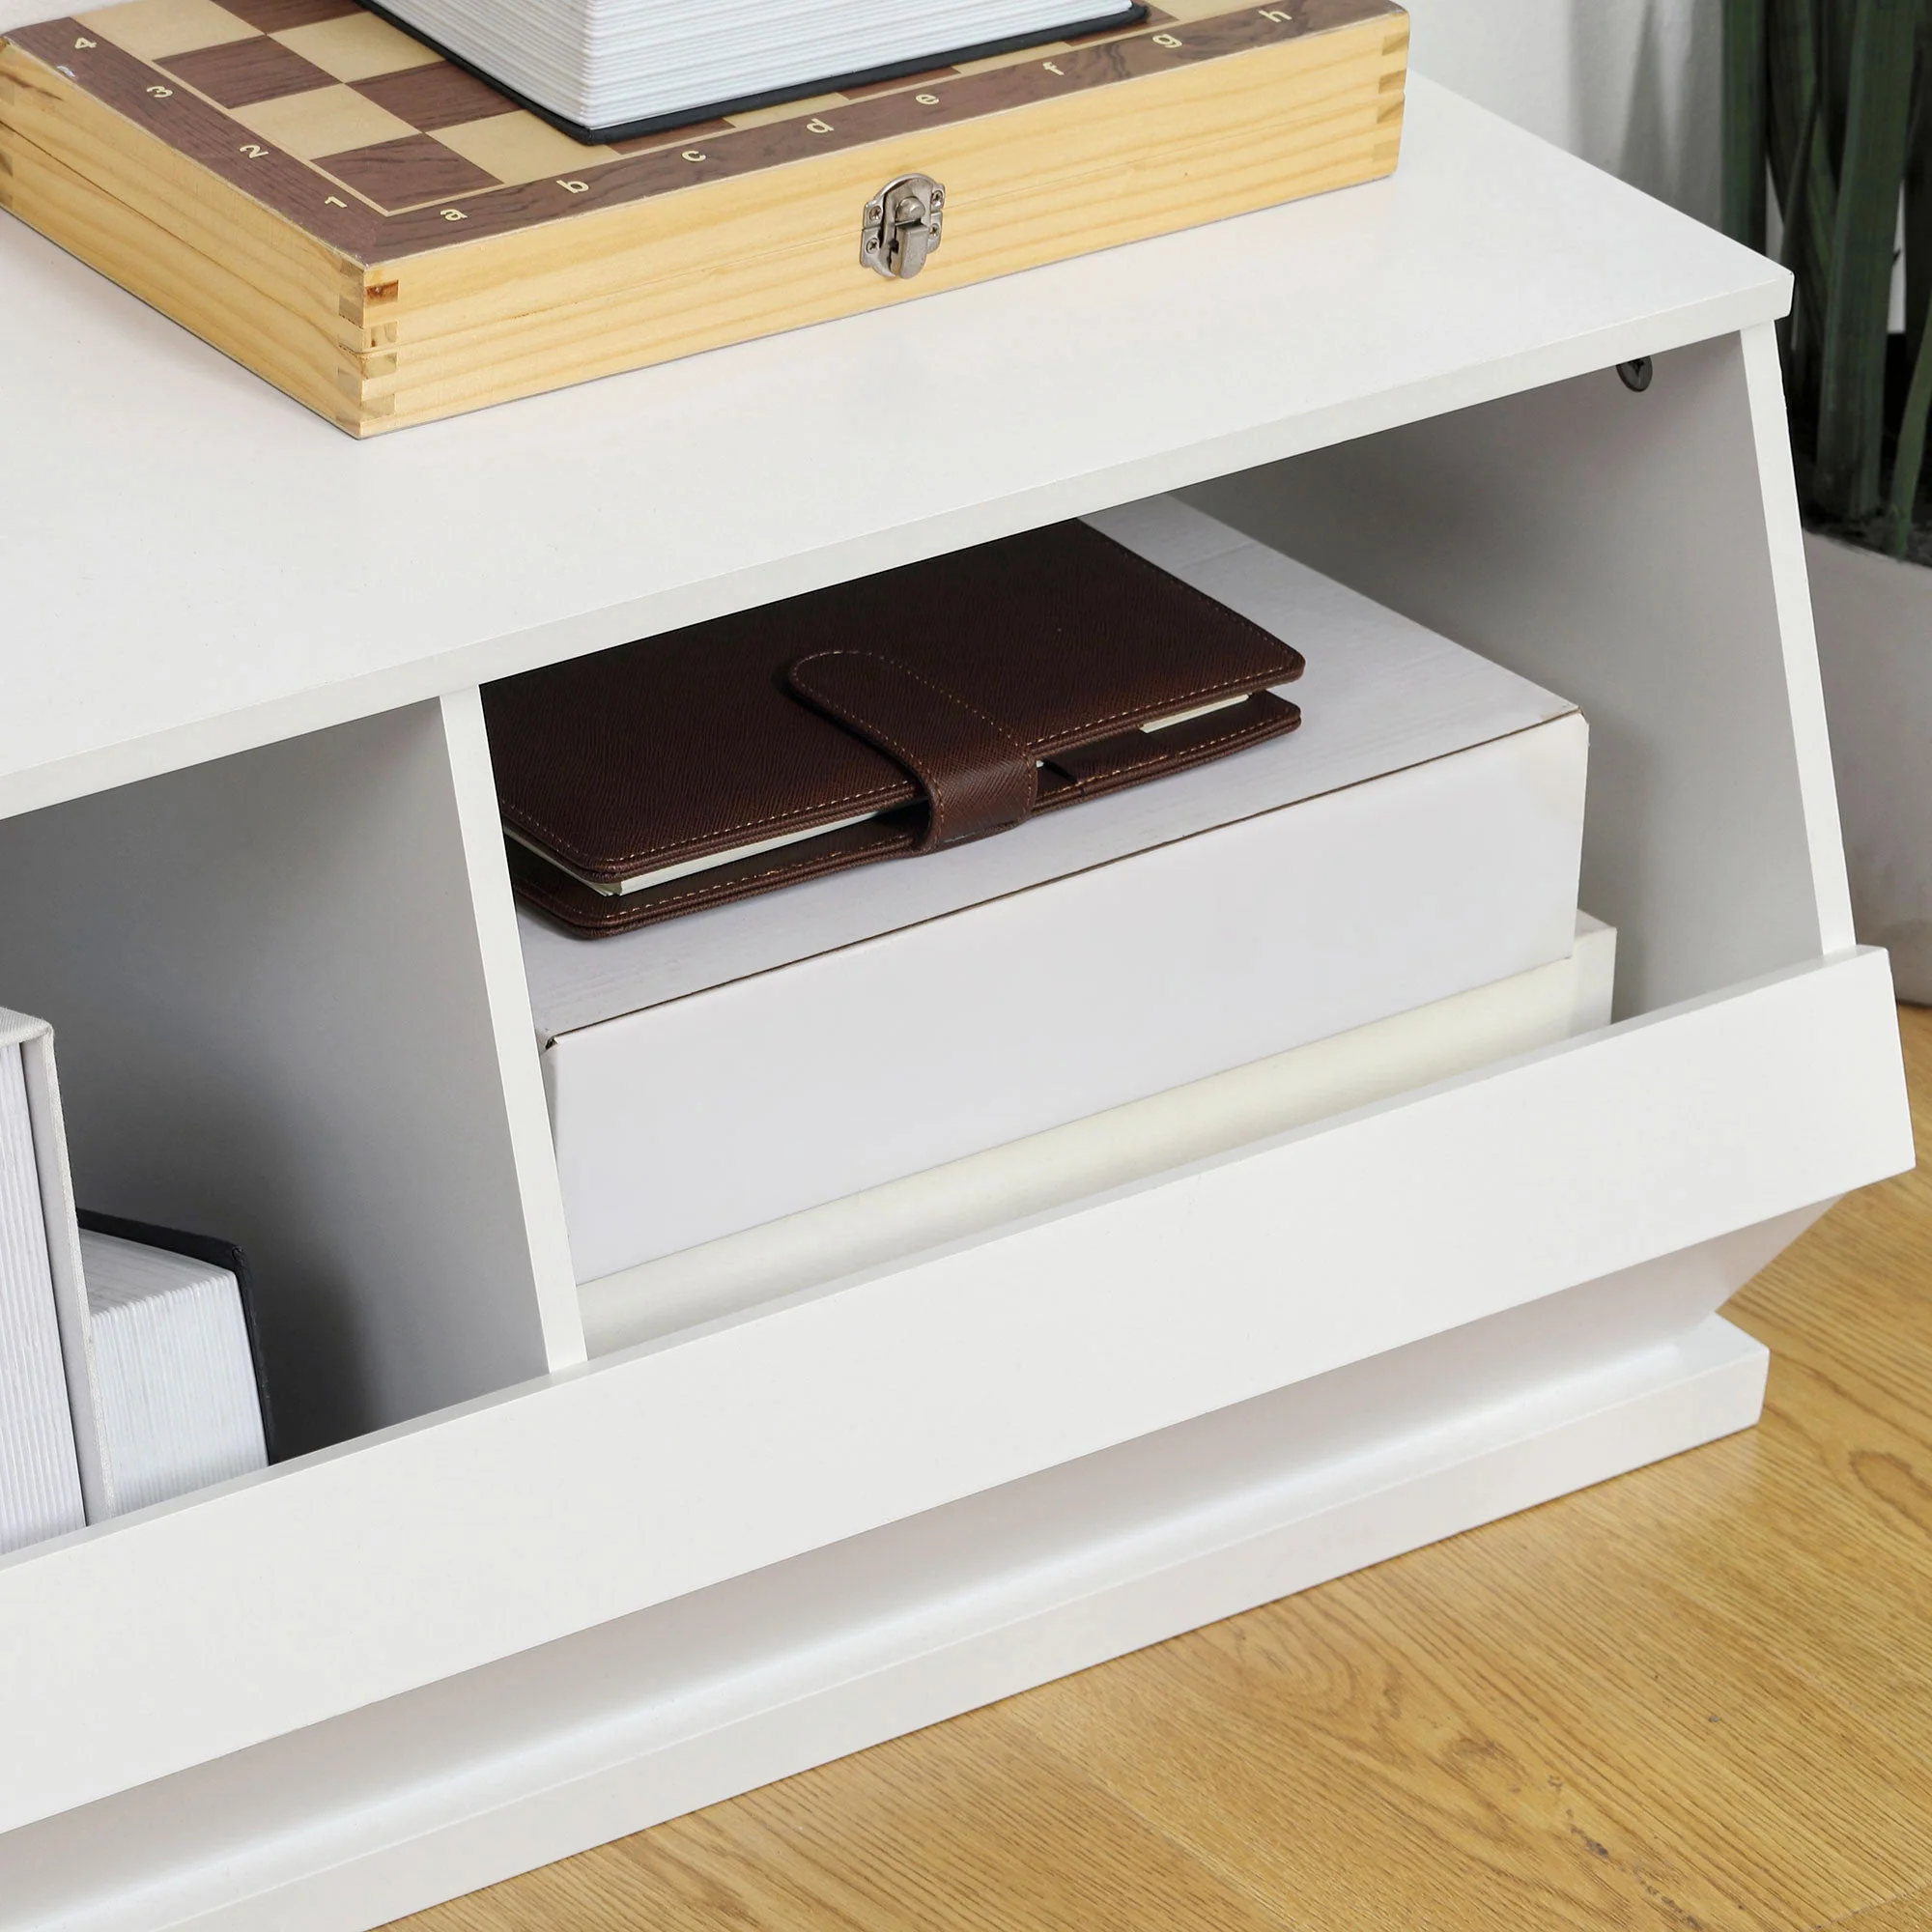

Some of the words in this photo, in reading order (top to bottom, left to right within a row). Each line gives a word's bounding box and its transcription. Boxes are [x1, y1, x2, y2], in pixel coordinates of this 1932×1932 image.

[74, 37, 98, 49] 4
[146, 85, 173, 99] 3
[440, 209, 468, 221] a
[555, 180, 589, 194] b
[681, 150, 706, 162] c
[806, 117, 835, 133] d
[915, 94, 940, 105] e
[1042, 61, 1065, 76] f
[1151, 33, 1183, 48] g
[1258, 10, 1293, 23] h
[239, 144, 270, 158] 2
[324, 195, 348, 209] 1
